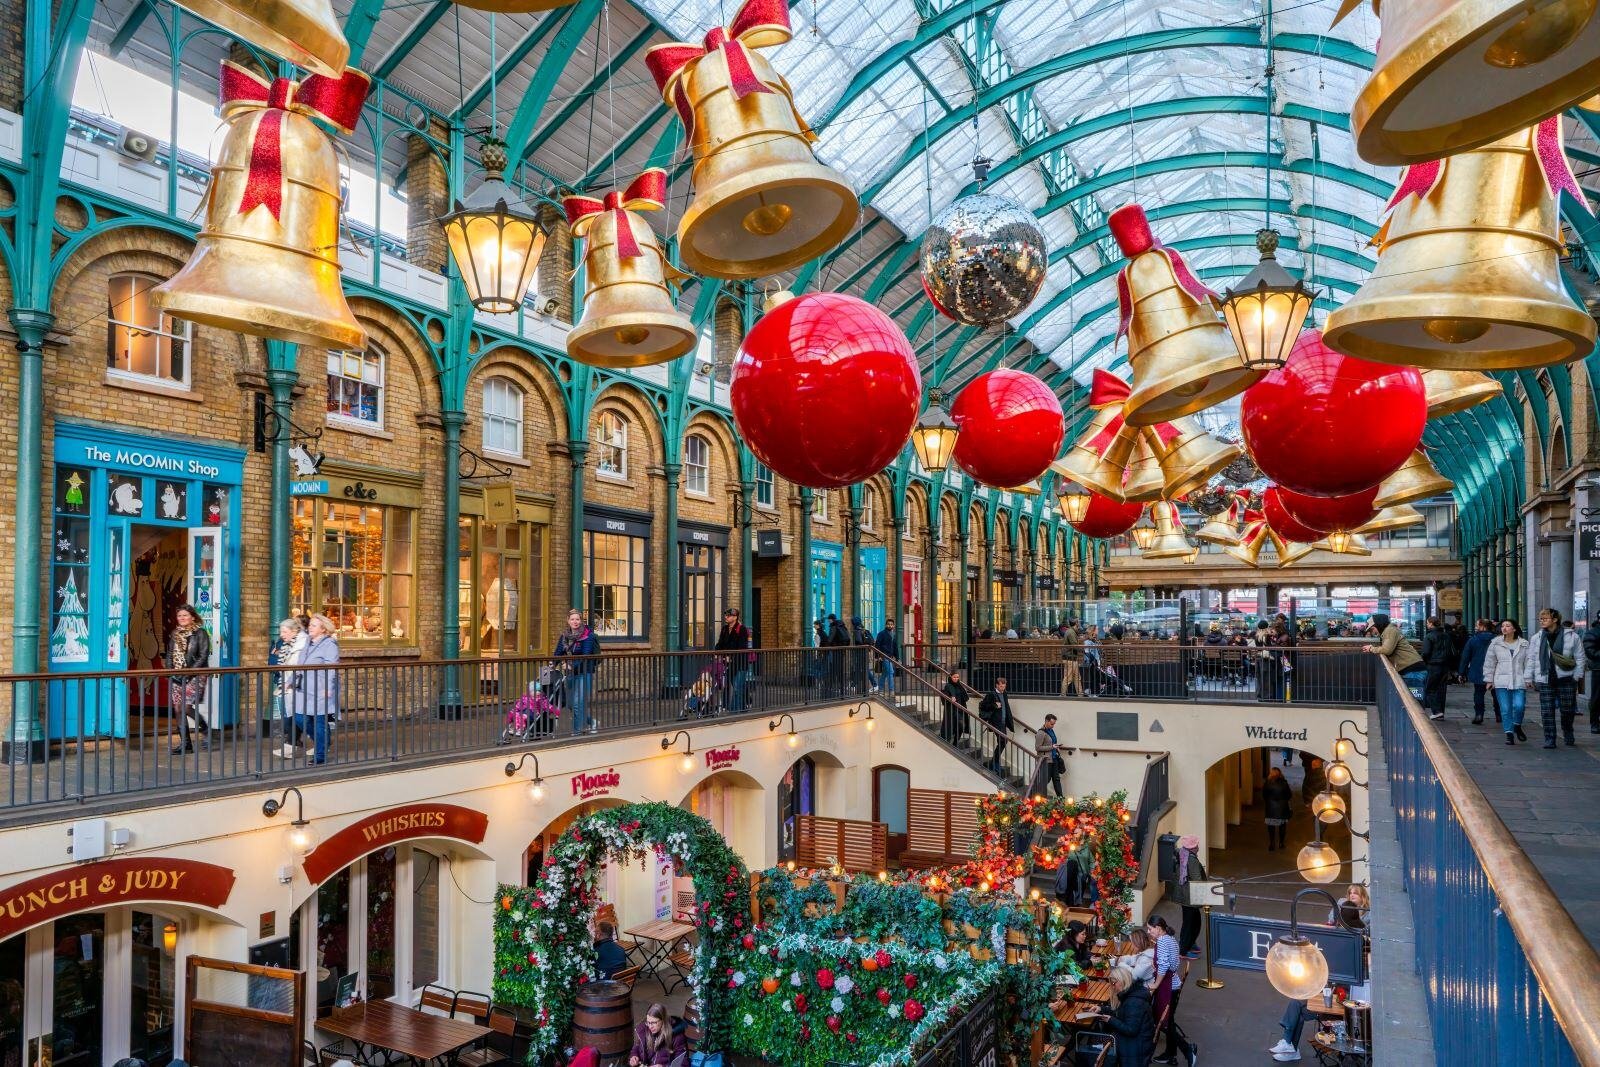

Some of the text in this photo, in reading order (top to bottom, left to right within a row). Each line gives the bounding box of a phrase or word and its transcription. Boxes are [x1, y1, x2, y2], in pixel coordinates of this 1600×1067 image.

[85, 446, 219, 478] The MOOMIN Shop
[292, 482, 321, 493] MOOMIN
[344, 482, 377, 500] e&e
[1581, 524, 1600, 533] PIC
[1245, 725, 1307, 741] Whittard
[705, 744, 740, 768] Floozie
[571, 767, 620, 796] Floozie
[362, 811, 446, 842] WHISKIES
[98, 874, 116, 893] &
[119, 869, 186, 895] JUDY
